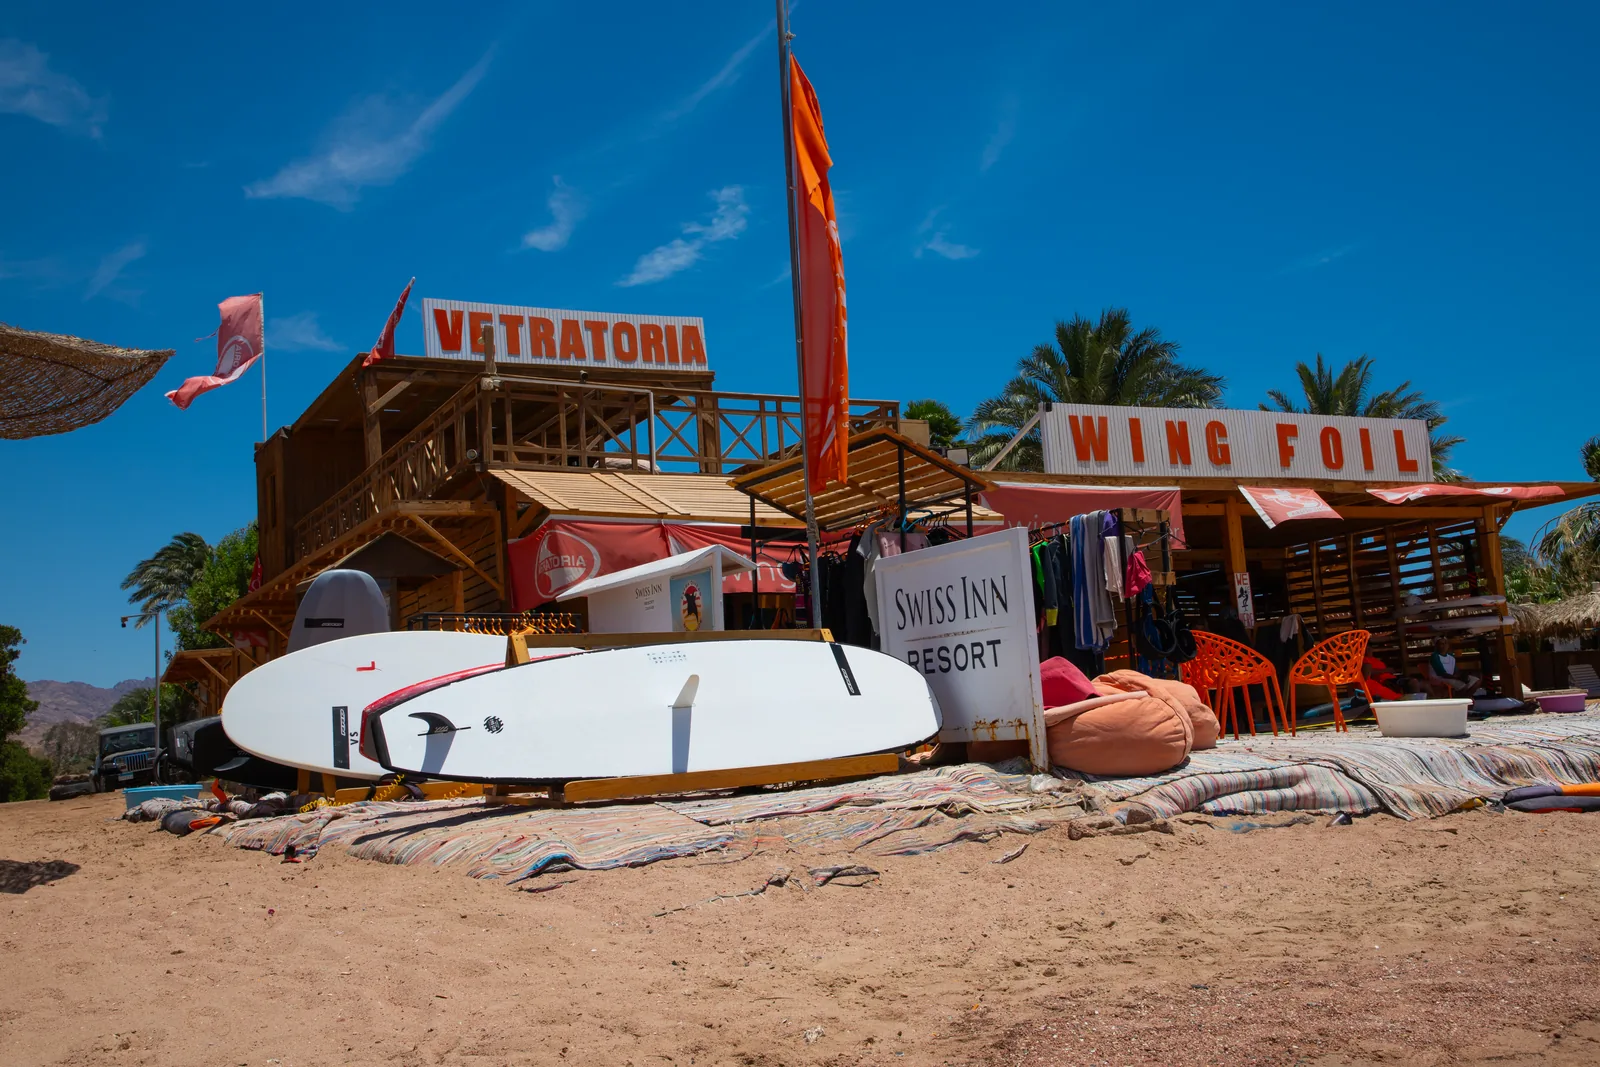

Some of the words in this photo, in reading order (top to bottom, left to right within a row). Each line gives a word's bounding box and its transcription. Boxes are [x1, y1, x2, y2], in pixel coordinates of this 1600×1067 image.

[433, 308, 707, 364] VETRATORIA
[1068, 414, 1232, 466] WING
[1275, 423, 1419, 472] FOIL
[907, 639, 1002, 675] RESORT
